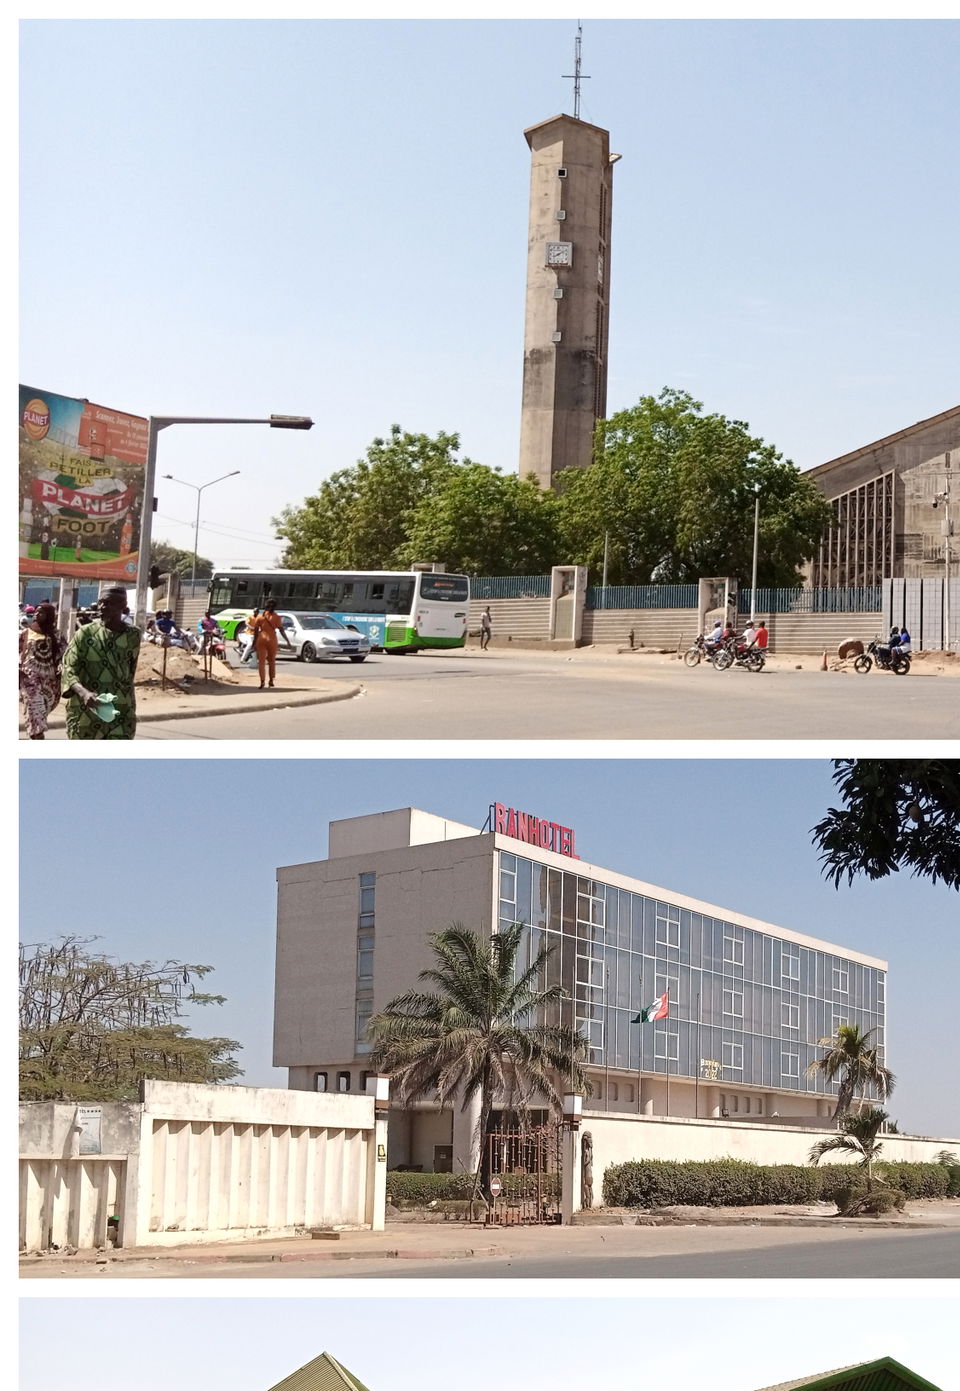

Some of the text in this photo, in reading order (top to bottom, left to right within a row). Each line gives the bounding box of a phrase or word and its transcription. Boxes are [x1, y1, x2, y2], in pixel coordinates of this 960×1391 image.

[23, 411, 49, 425] PLANET
[70, 458, 92, 467] FAIS
[42, 483, 126, 513] PLANET
[57, 518, 110, 533] FOOT
[494, 801, 580, 860] RANHOTEL
